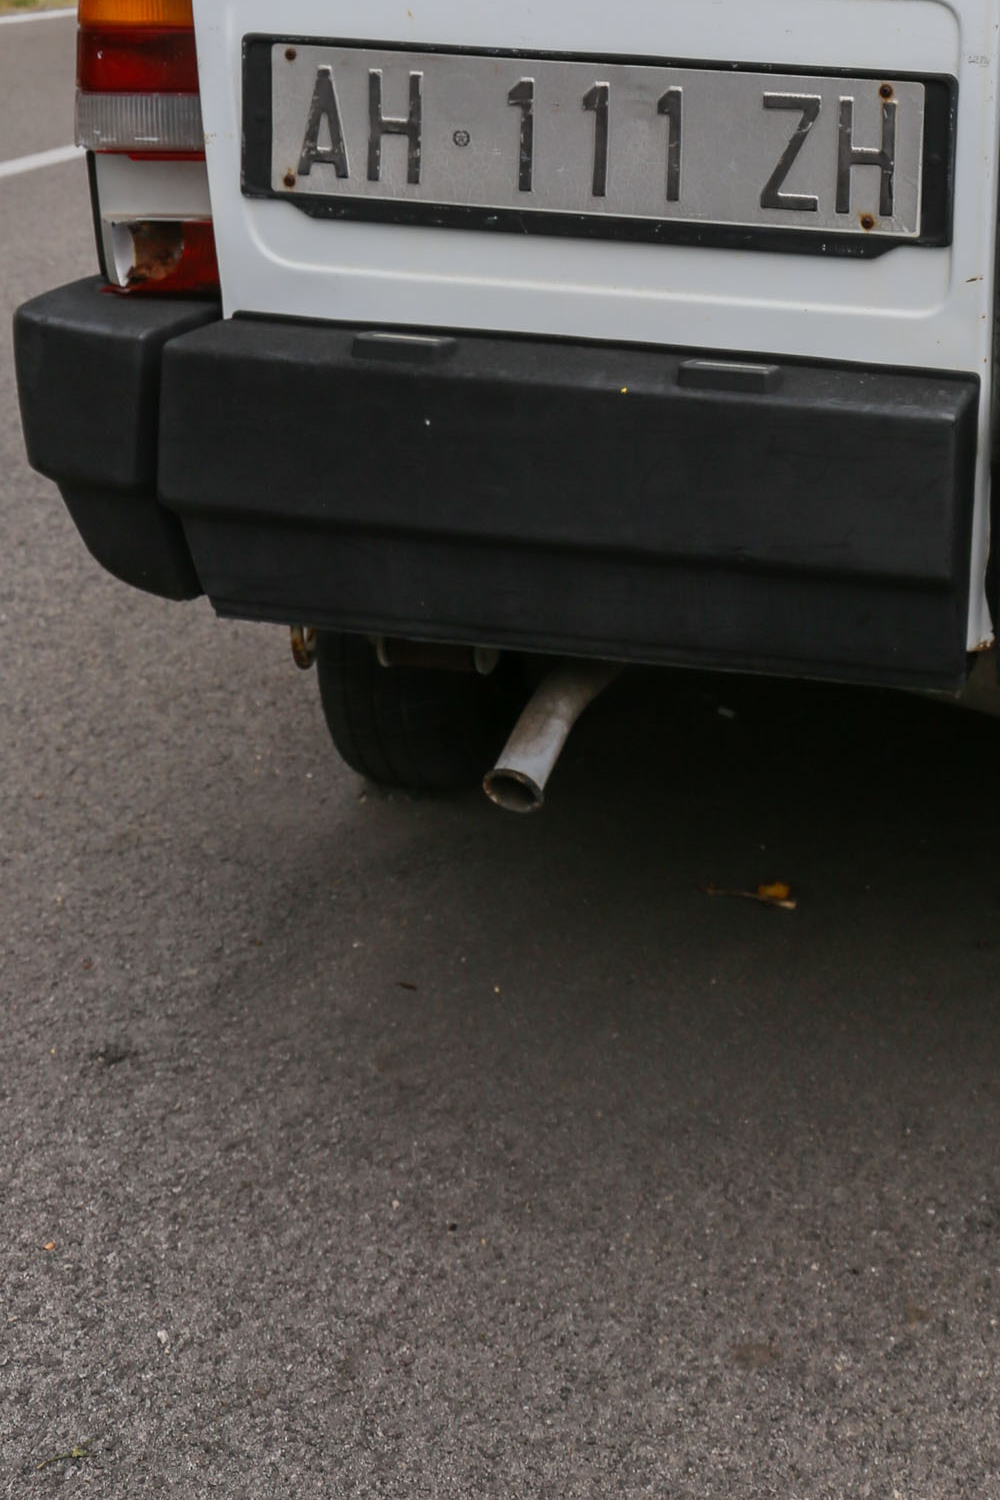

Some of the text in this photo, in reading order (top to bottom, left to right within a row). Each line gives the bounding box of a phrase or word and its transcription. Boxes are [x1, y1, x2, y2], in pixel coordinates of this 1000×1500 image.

[299, 65, 897, 217] AH 111 ZH
